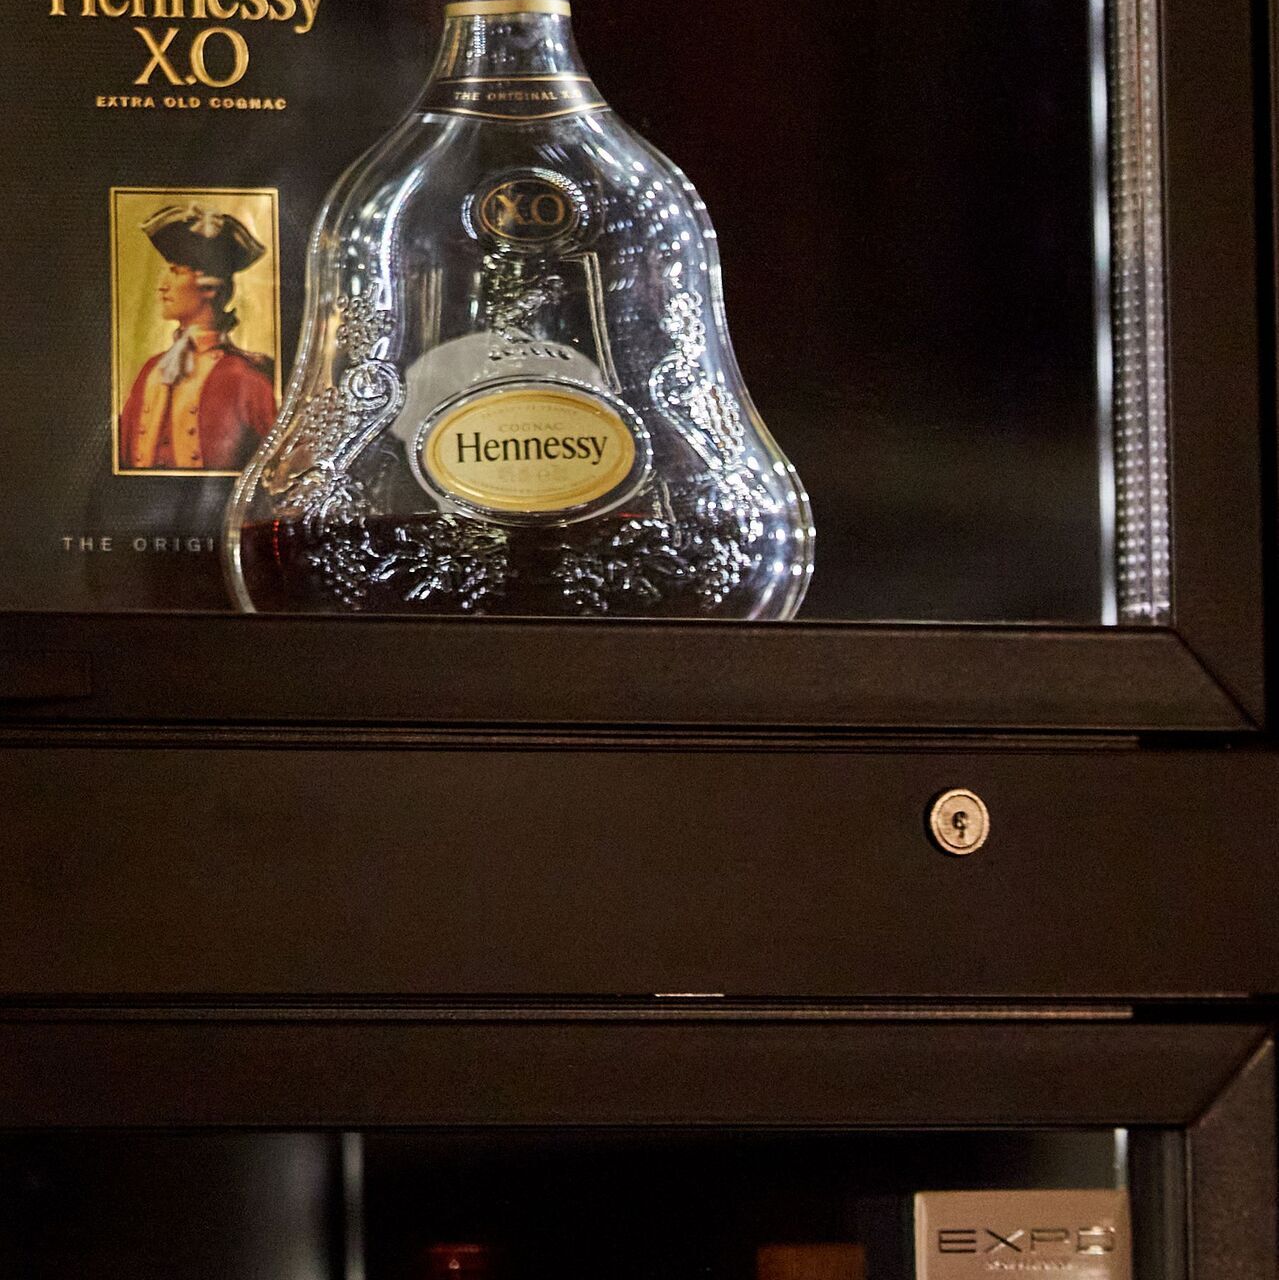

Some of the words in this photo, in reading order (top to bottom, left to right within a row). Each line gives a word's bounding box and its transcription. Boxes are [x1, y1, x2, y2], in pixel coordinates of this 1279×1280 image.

[95, 95, 156, 109] EXTRA
[162, 96, 201, 110] OLD
[209, 97, 289, 111] COGNAC
[453, 91, 481, 102] THE
[486, 90, 558, 102] ORIGINAL
[498, 422, 577, 434] COGNAC
[456, 430, 608, 466] Hennessy
[61, 536, 113, 553] THE
